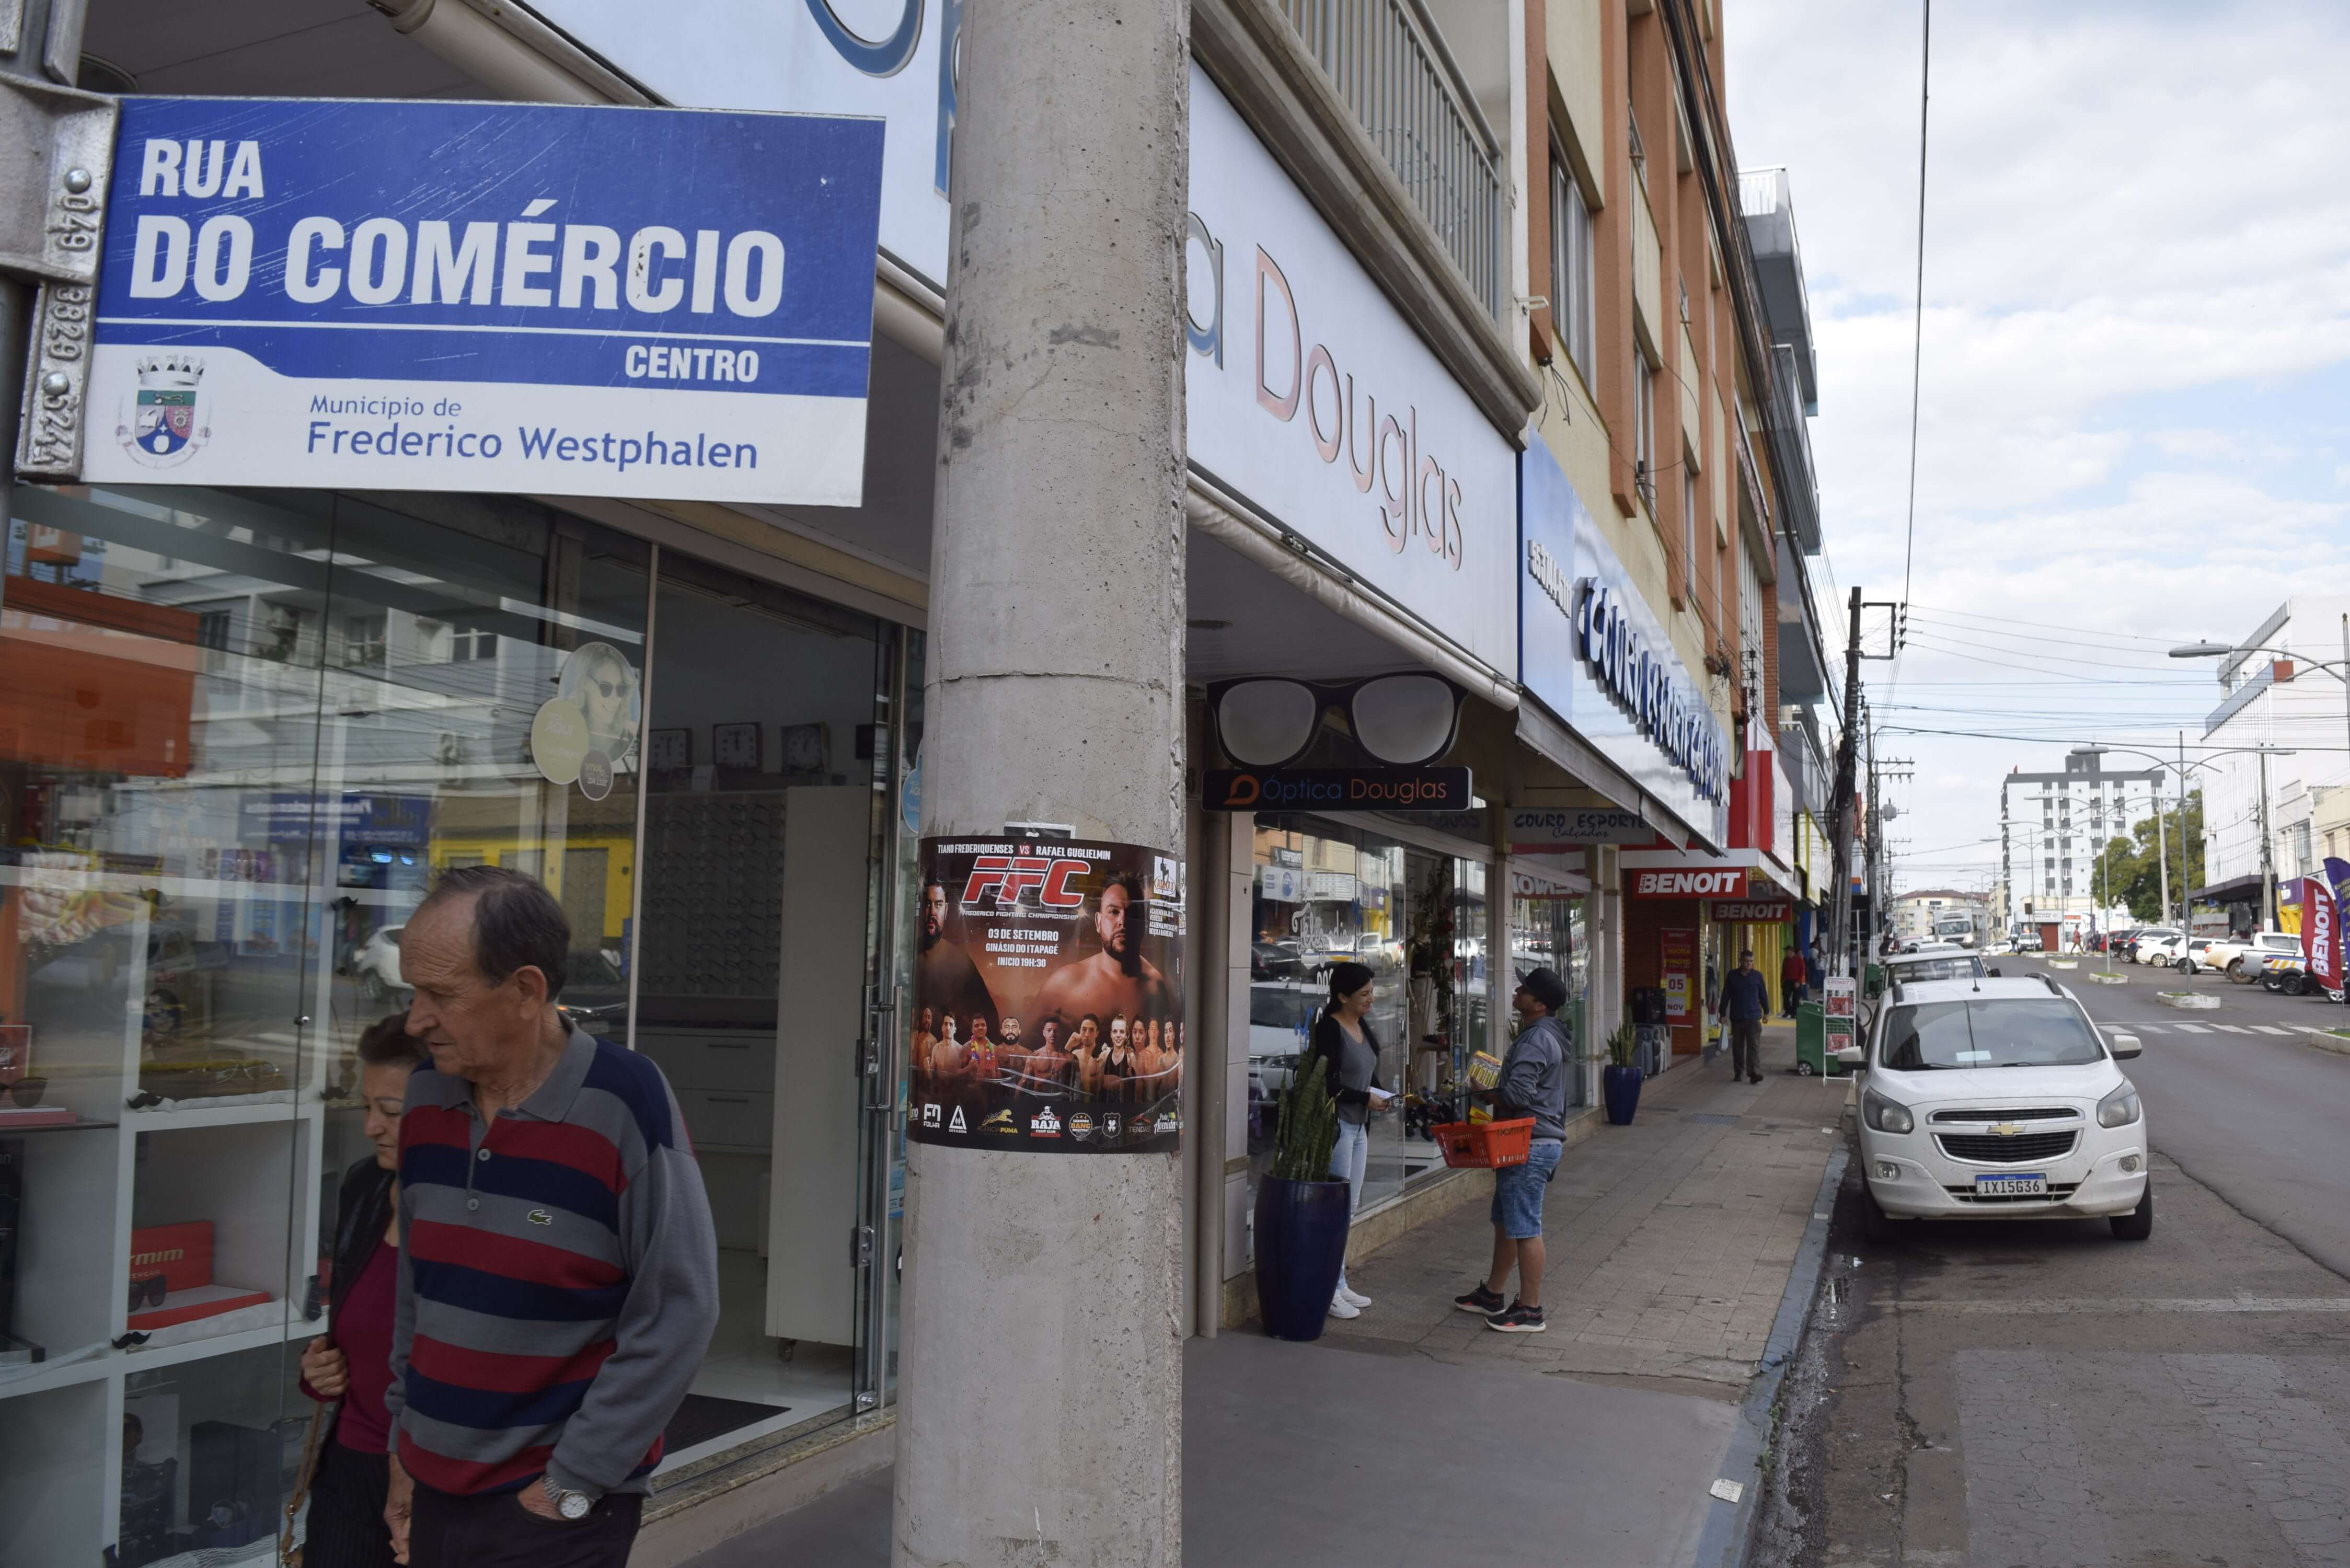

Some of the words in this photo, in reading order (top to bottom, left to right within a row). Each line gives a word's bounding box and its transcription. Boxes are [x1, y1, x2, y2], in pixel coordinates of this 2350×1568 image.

[140, 139, 264, 198] RUA
[130, 215, 254, 302] DO
[284, 199, 785, 318] COMÉRCIO
[626, 345, 759, 383] CENTRO
[310, 395, 424, 420] Município
[433, 398, 462, 416] de
[1256, 243, 1462, 572] Douglas
[307, 421, 502, 458] Frederico
[519, 426, 758, 472] Westphalen
[1262, 775, 1342, 803] Óptica
[1350, 779, 1447, 803] Douglas
[1514, 814, 1565, 828] COURO
[1577, 813, 1652, 828] ESPORTE
[1552, 826, 1608, 839] Calçados
[954, 844, 1013, 855] FREDERIQUENSES
[1019, 845, 1030, 855] VS
[1036, 846, 1066, 857] RAFAEL
[1067, 848, 1111, 860] GUGLIELMIN
[961, 856, 1091, 908] FFC
[1638, 872, 1741, 893] BENOIT
[1028, 912, 1079, 920] CHAMPIONSHIP
[1715, 903, 1787, 918] BENOIT
[988, 928, 999, 939] 03
[1000, 929, 1011, 939] DE
[1013, 929, 1059, 941] SETEMBRO
[2311, 889, 2330, 976] BENOIT
[985, 942, 1015, 953] GINÁSIO
[1016, 944, 1027, 953] DO
[1027, 943, 1058, 955] ITAPAGÉ
[997, 956, 1020, 966] INICIO
[1021, 957, 1046, 967] 19H:30
[1669, 979, 1684, 990] 05
[1031, 1120, 1061, 1129] RAJA
[1154, 1119, 1176, 1134] Avenida
[1984, 1180, 2040, 1194] IXI5G36
